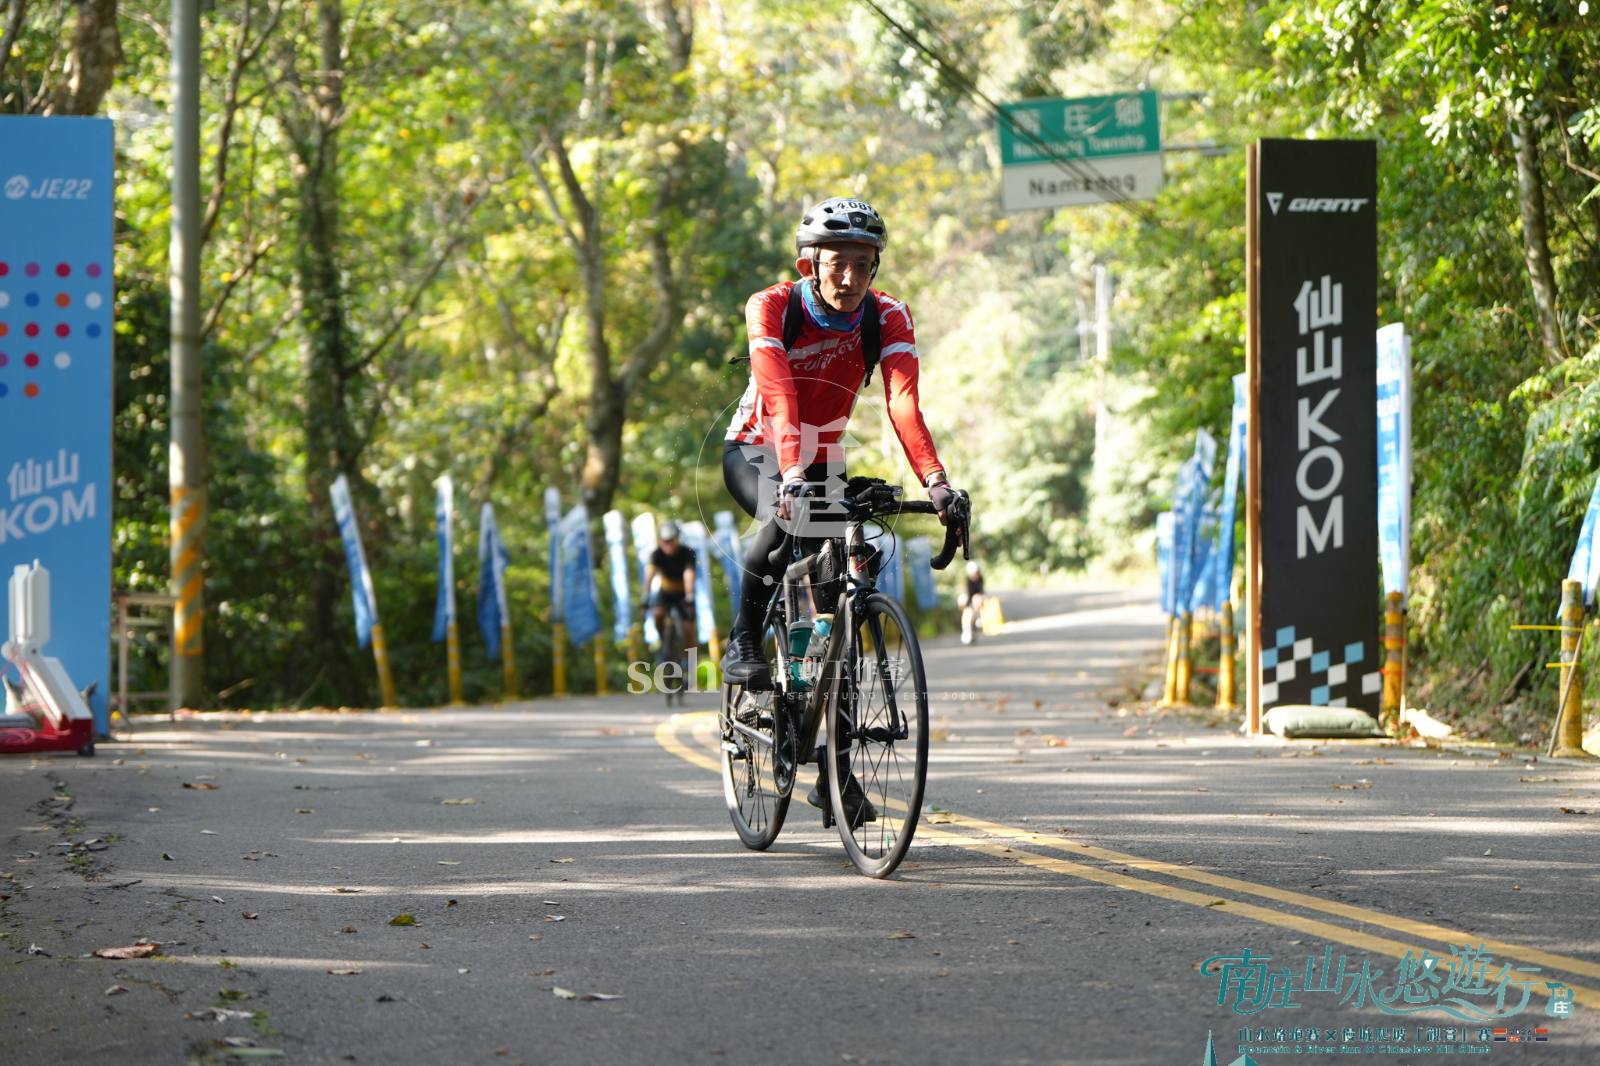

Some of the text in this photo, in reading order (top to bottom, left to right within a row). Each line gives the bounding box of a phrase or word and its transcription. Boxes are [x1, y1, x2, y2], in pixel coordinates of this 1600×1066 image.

[31, 178, 93, 200] JE22
[1287, 197, 1369, 212] GIANT
[7, 448, 79, 502] 仙山
[0, 482, 96, 544] KOM
